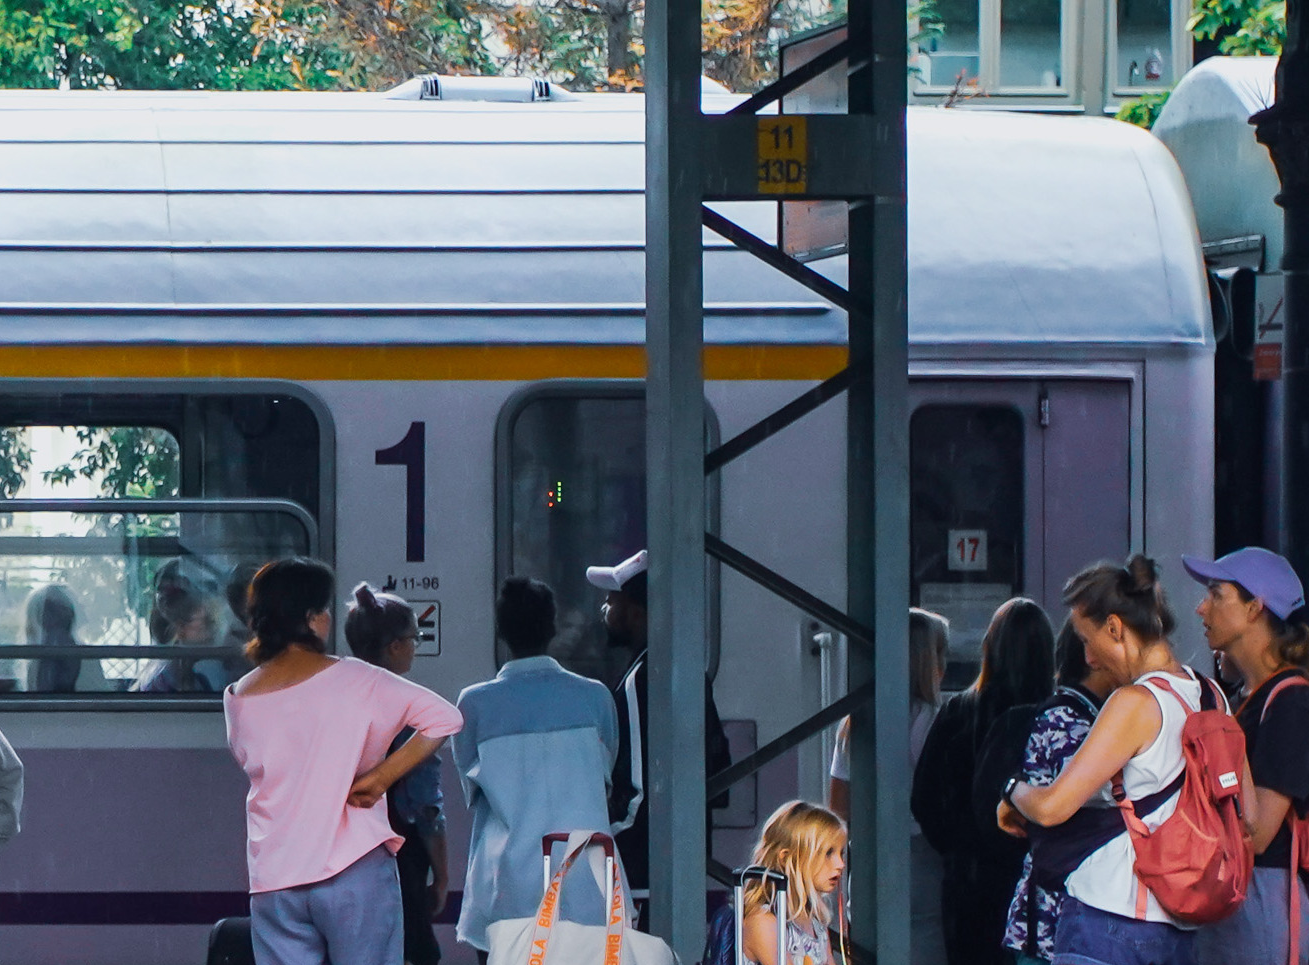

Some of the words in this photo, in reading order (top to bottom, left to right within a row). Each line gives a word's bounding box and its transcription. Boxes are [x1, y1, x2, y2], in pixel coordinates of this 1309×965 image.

[770, 125, 793, 150] 11
[375, 421, 425, 563] 1
[956, 537, 980, 562] 17
